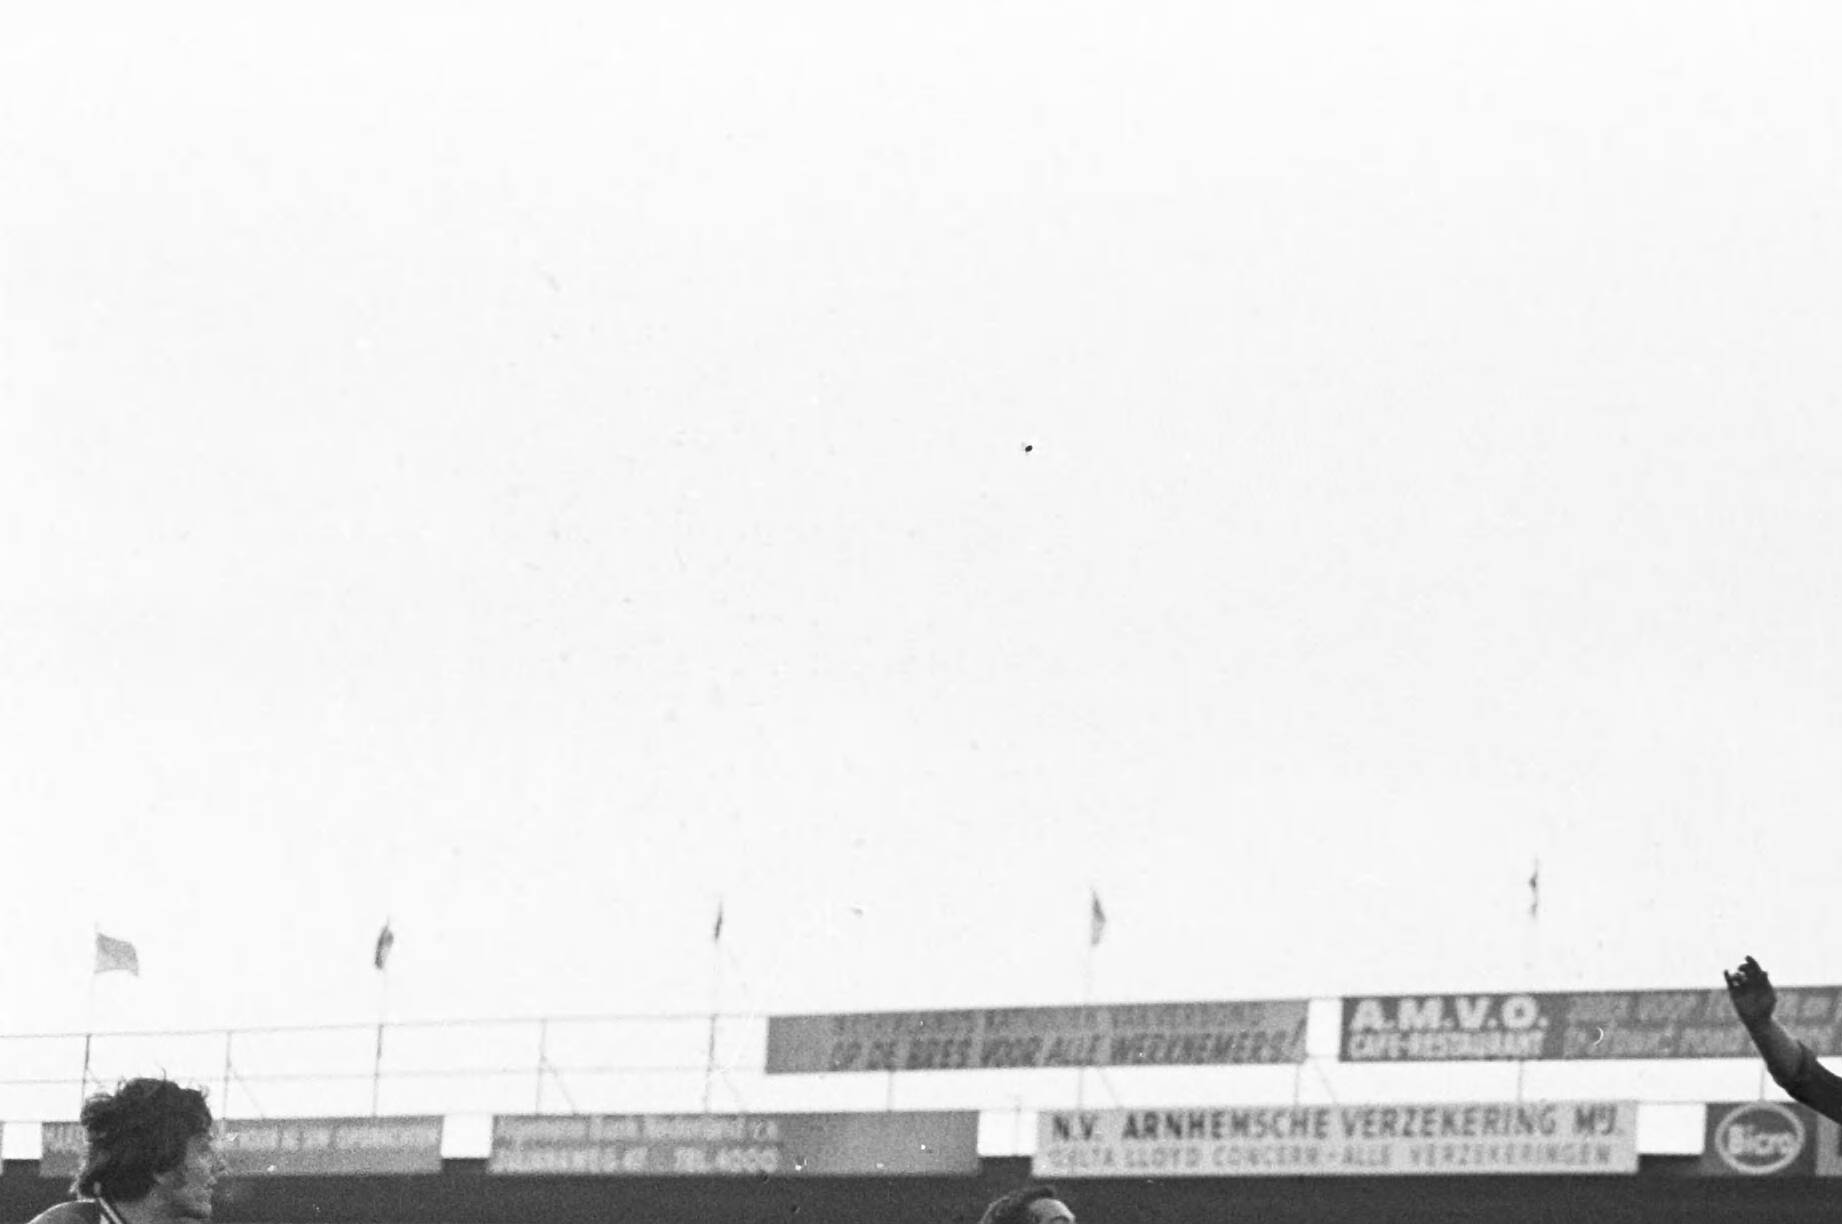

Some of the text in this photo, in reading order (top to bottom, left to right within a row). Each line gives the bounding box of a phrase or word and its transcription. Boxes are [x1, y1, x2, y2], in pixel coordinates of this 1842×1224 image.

[1351, 996, 1549, 1030] A.M.V.O.
[1122, 1109, 1330, 1141] ARNHEMSCHE
[1341, 1105, 1558, 1138] VERZEKERING
